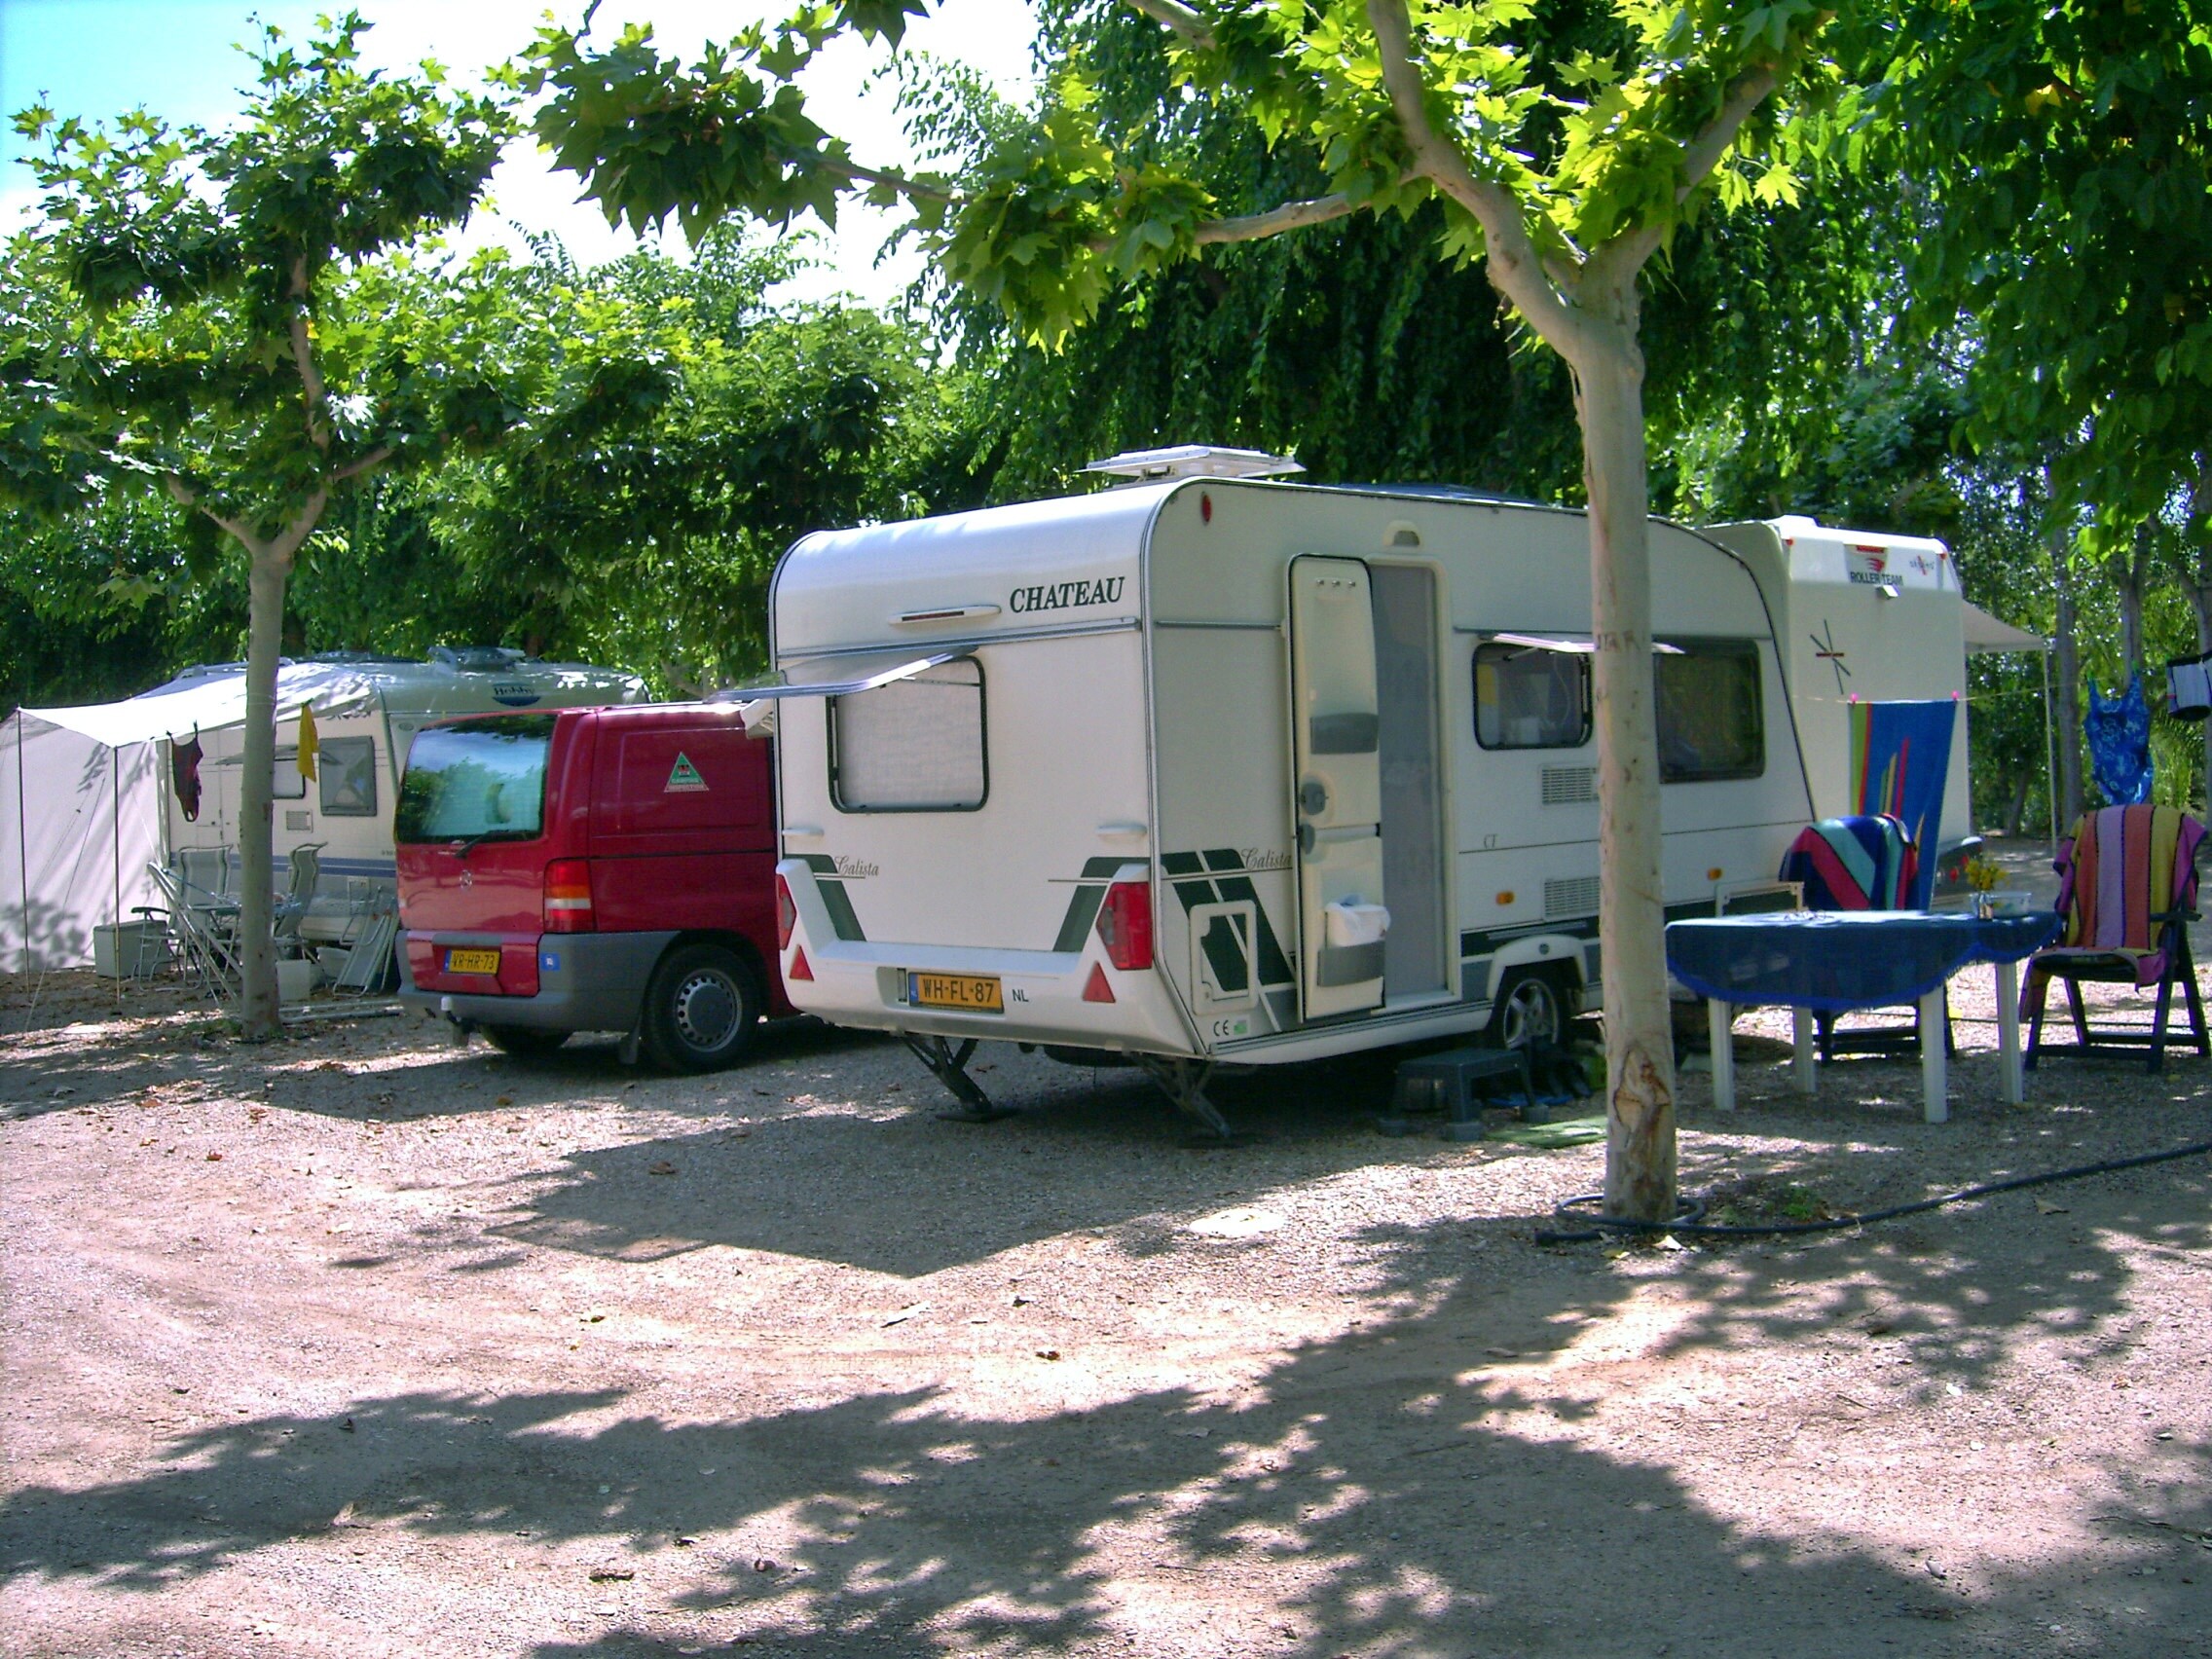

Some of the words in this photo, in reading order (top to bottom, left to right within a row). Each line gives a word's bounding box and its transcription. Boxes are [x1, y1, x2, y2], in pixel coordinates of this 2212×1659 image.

[1850, 571, 1880, 584] ROLLER
[1881, 573, 1903, 586] TEAM
[1010, 576, 1124, 613] CHATEAU
[494, 686, 535, 696] Hobby
[834, 855, 879, 876] Calista
[1241, 847, 1293, 870] Calista
[923, 978, 994, 1003] WH-FL-87
[1012, 989, 1029, 1002] NL
